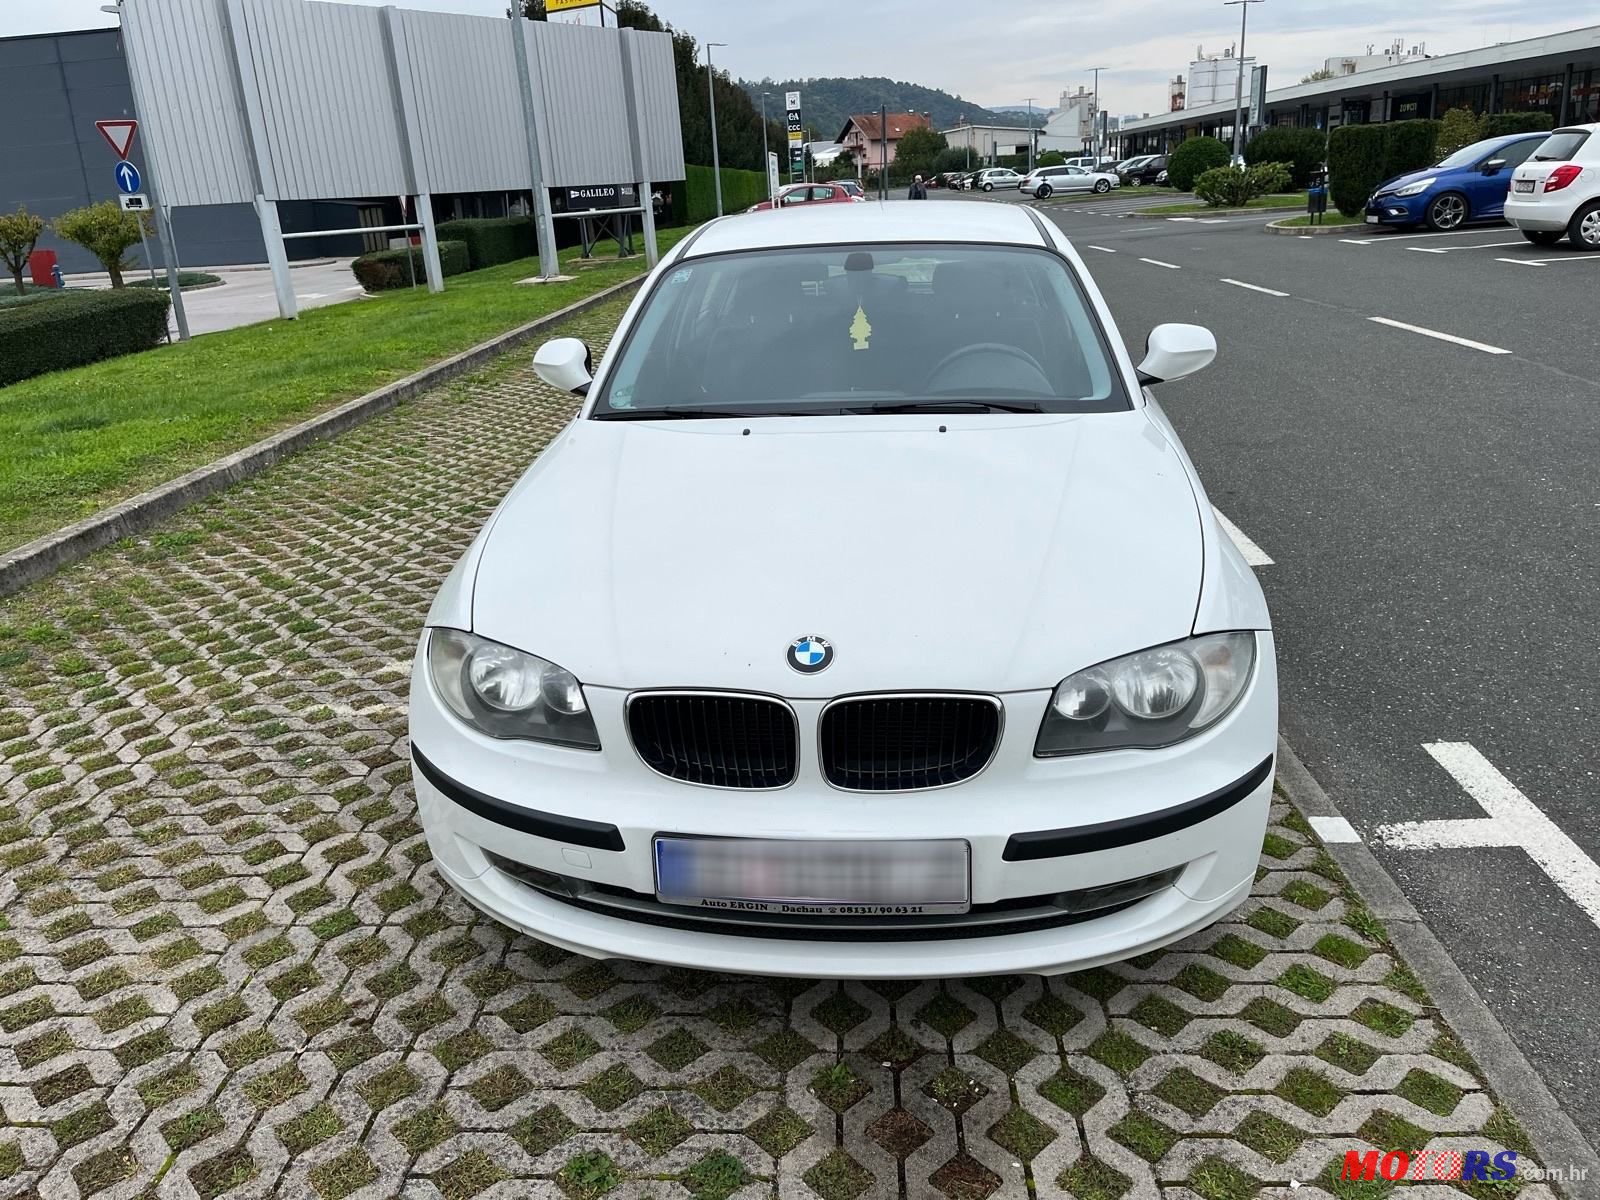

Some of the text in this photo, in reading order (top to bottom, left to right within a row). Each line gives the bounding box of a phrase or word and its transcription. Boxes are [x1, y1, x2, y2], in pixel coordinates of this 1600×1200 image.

[580, 187, 615, 198] GALILEO
[700, 899, 727, 907] Auto
[730, 901, 768, 911] ERGIN
[781, 905, 823, 913] Dachau
[895, 905, 908, 914] 63
